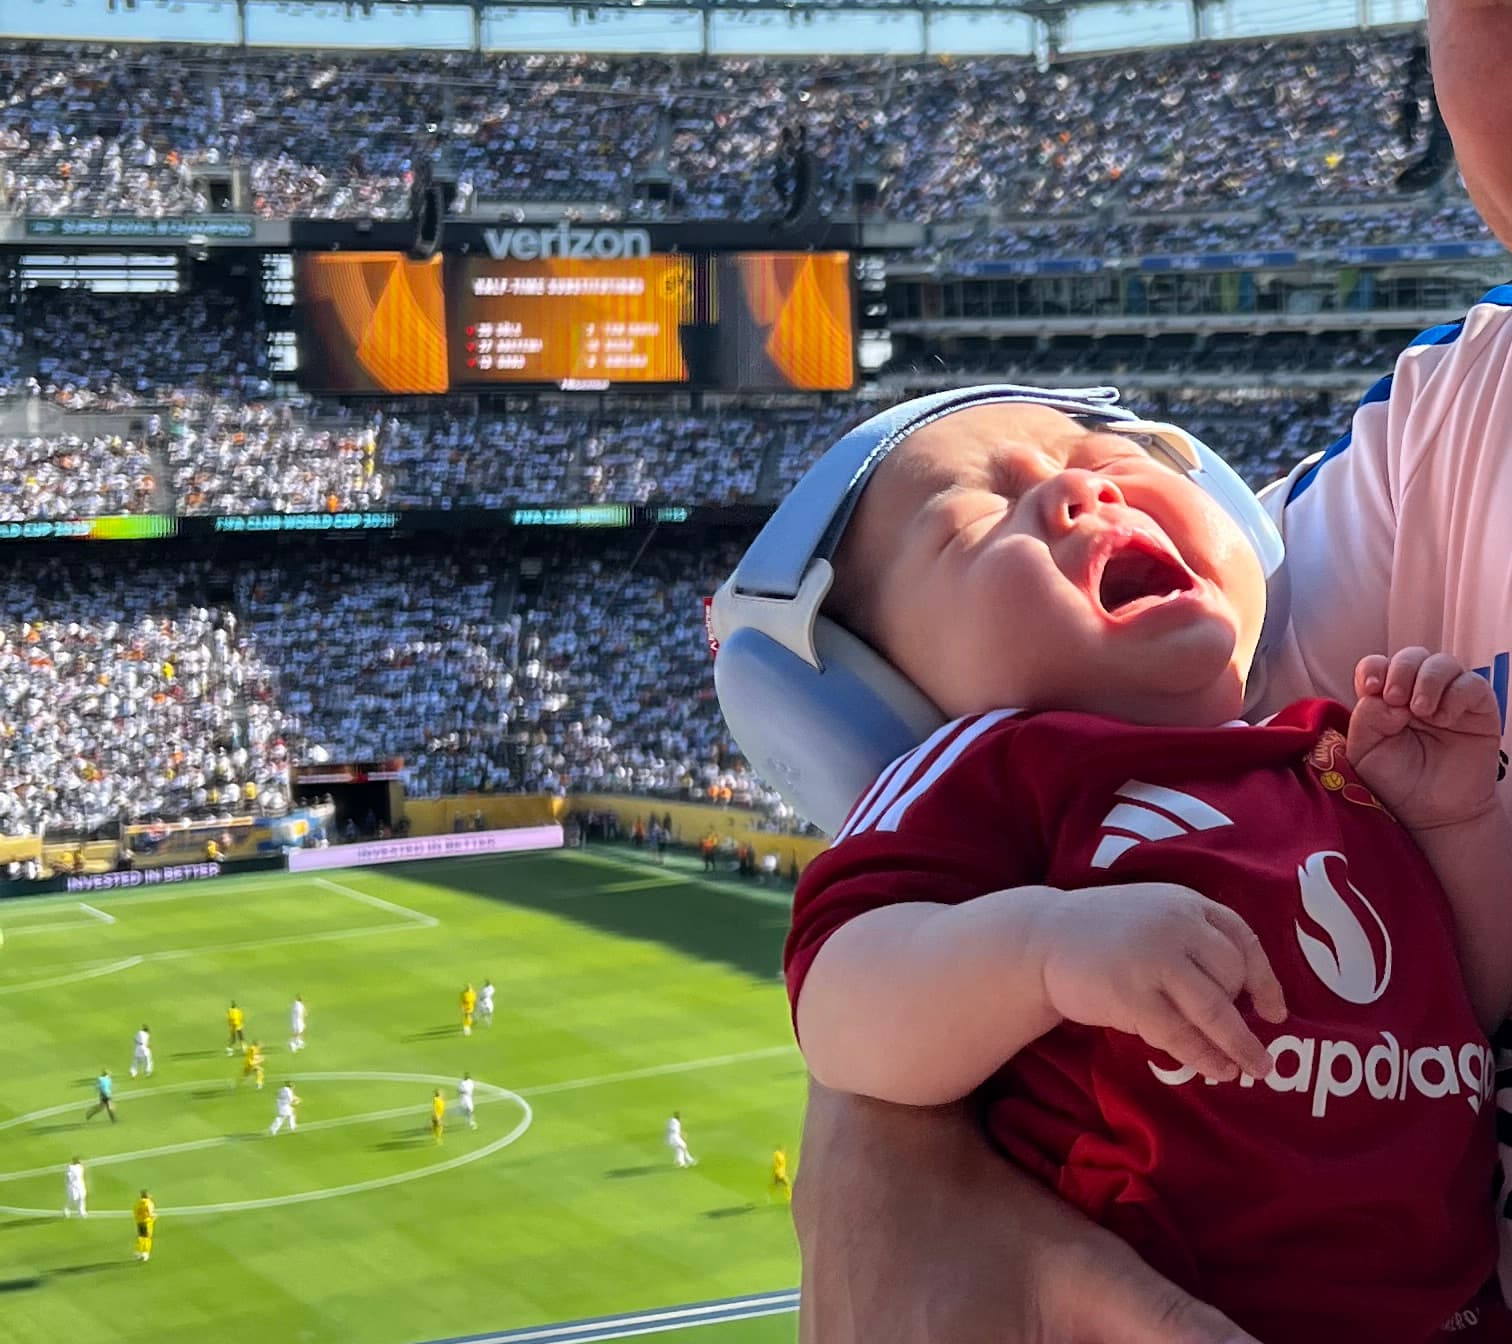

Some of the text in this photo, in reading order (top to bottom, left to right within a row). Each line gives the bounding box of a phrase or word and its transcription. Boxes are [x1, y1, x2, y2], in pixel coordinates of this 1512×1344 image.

[484, 220, 650, 260] verizon
[67, 862, 220, 892] INVESTED IN BETTER
